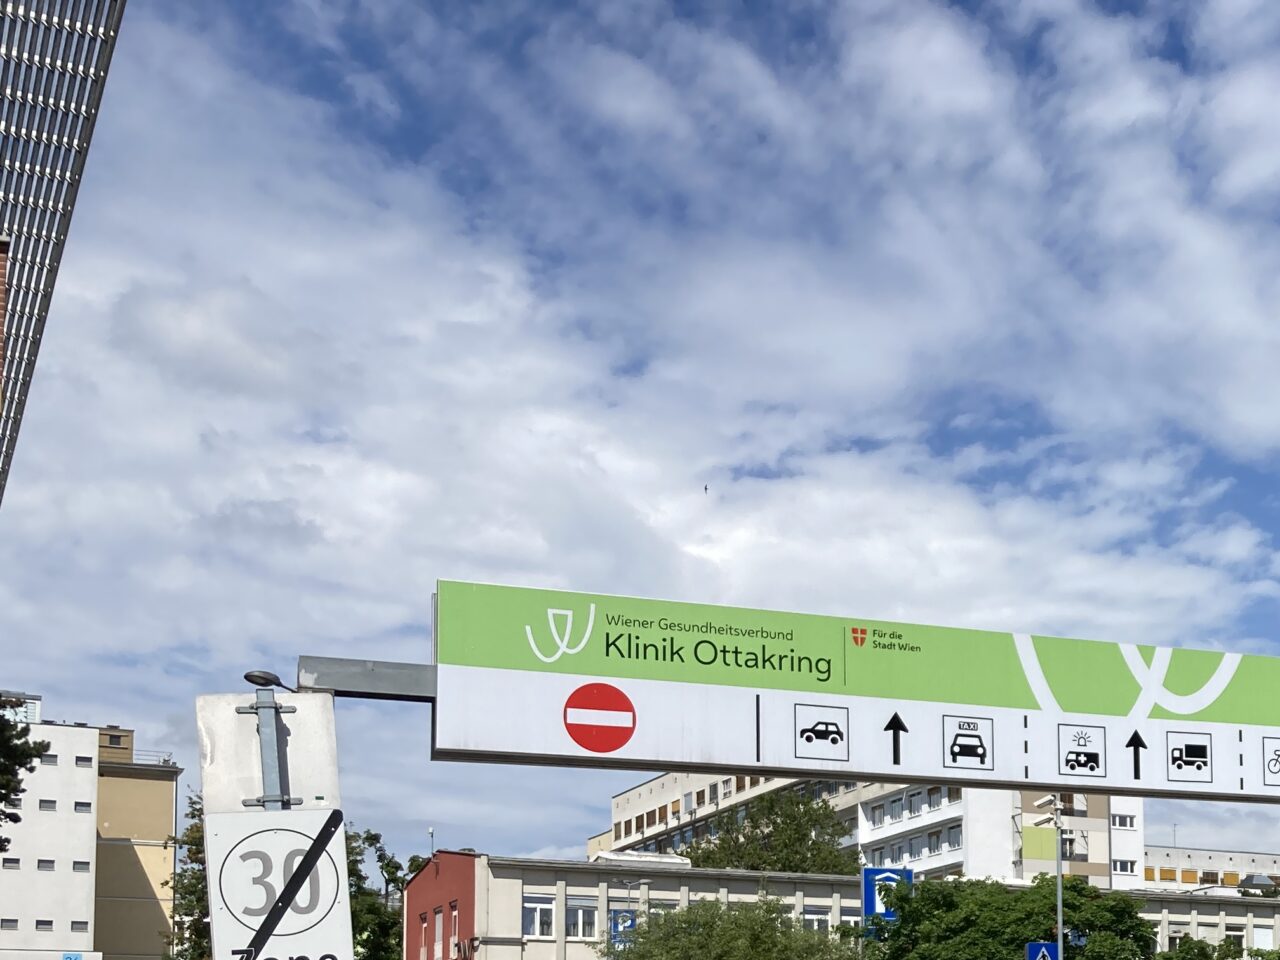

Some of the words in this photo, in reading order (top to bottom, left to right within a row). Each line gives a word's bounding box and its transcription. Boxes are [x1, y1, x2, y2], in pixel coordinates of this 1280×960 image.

[605, 613, 655, 630] Wiener
[658, 617, 794, 642] Gesundheitsverbund
[872, 629, 887, 639] Für
[889, 630, 903, 640] die
[605, 632, 685, 664] Klinik
[694, 639, 833, 682] Ottakring
[872, 640, 896, 651] Stadt
[898, 642, 922, 653] Wien
[960, 722, 978, 731] TAXI
[239, 848, 321, 917] 30
